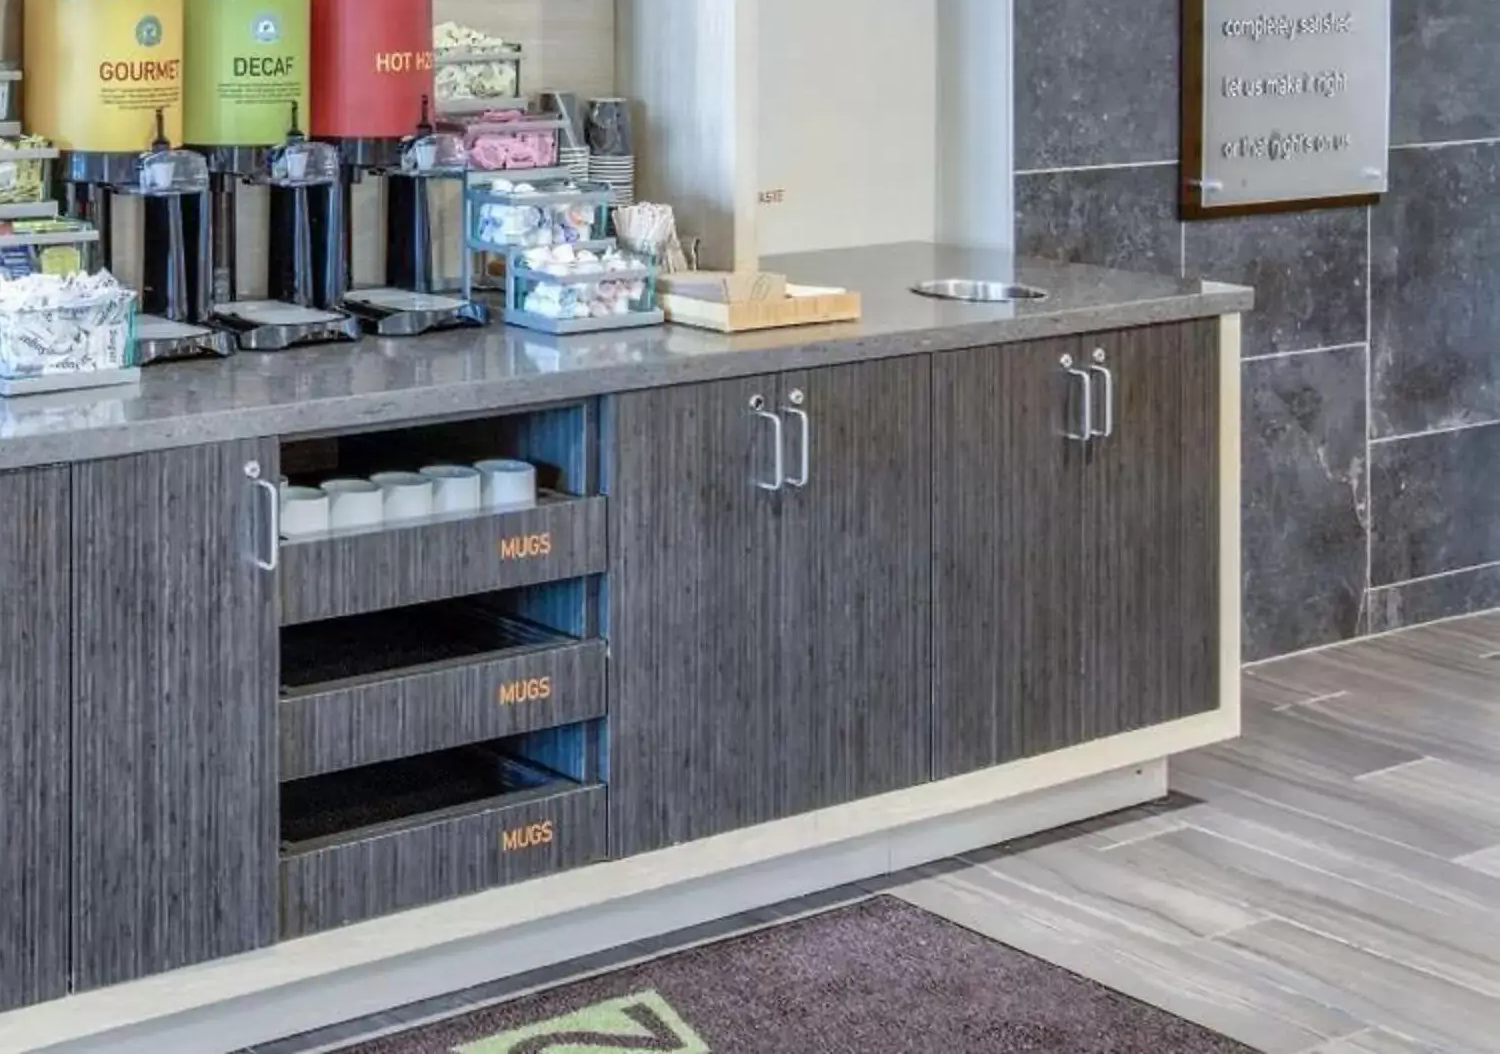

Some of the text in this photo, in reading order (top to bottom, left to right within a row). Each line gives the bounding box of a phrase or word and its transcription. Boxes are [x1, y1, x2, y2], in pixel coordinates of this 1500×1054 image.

[99, 59, 180, 82] GOURMET
[233, 56, 294, 77] DECAF
[377, 51, 413, 73] HOT
[501, 531, 551, 559] MUGS
[500, 676, 550, 706] MUGS
[503, 820, 553, 851] MUGS
